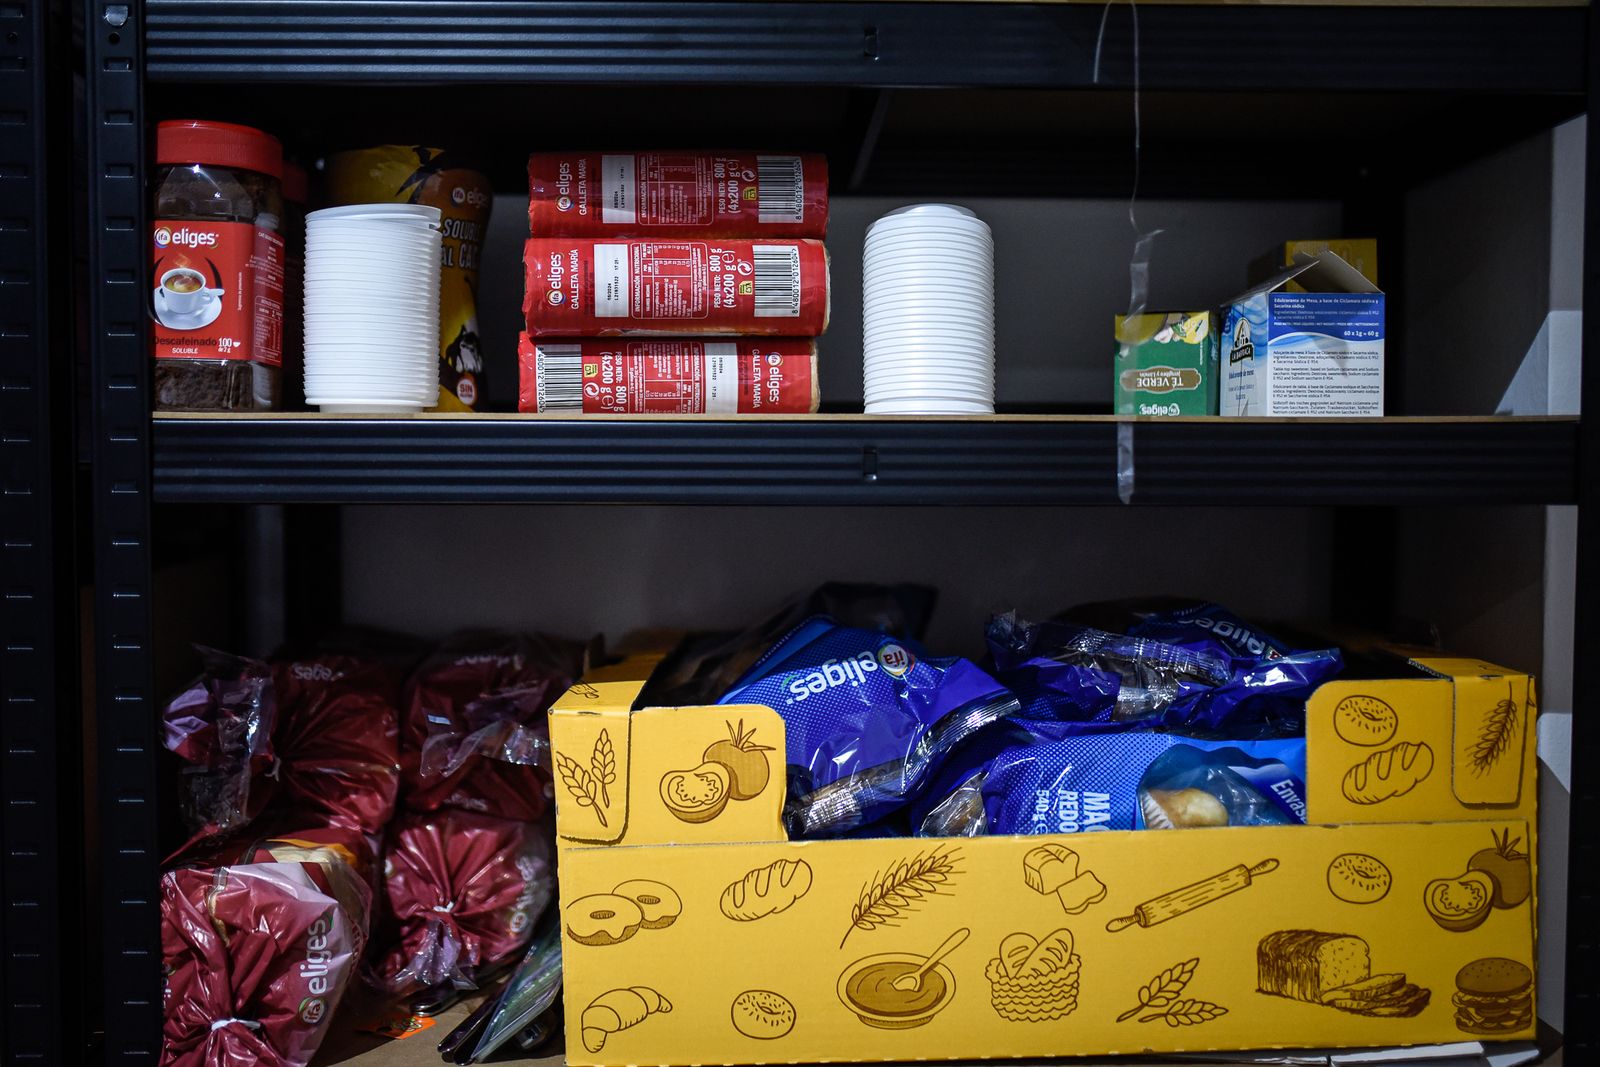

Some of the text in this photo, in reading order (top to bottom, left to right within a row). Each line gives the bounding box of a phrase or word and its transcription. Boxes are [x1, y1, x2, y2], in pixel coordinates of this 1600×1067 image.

[556, 162, 573, 195] eliges
[714, 163, 725, 178] 800
[578, 180, 588, 216] GALLETA
[728, 180, 742, 214] (4x200
[172, 228, 216, 248] eliges
[548, 253, 564, 290] eliges
[568, 249, 578, 274] MARÍA
[710, 254, 721, 272] 800
[727, 263, 736, 271] g
[724, 274, 736, 308] (4x200
[218, 338, 232, 347] 100
[600, 352, 614, 384] (4x200
[752, 349, 763, 408] GALLETA MARÍA
[1137, 376, 1184, 388] TÉ VERDE
[460, 384, 473, 392] SIN
[615, 385, 626, 404] 800
[767, 366, 782, 402] eliges
[1142, 404, 1168, 416] eliges
[790, 650, 905, 702] ifa eliges
[300, 919, 332, 1020] eliges ifa
